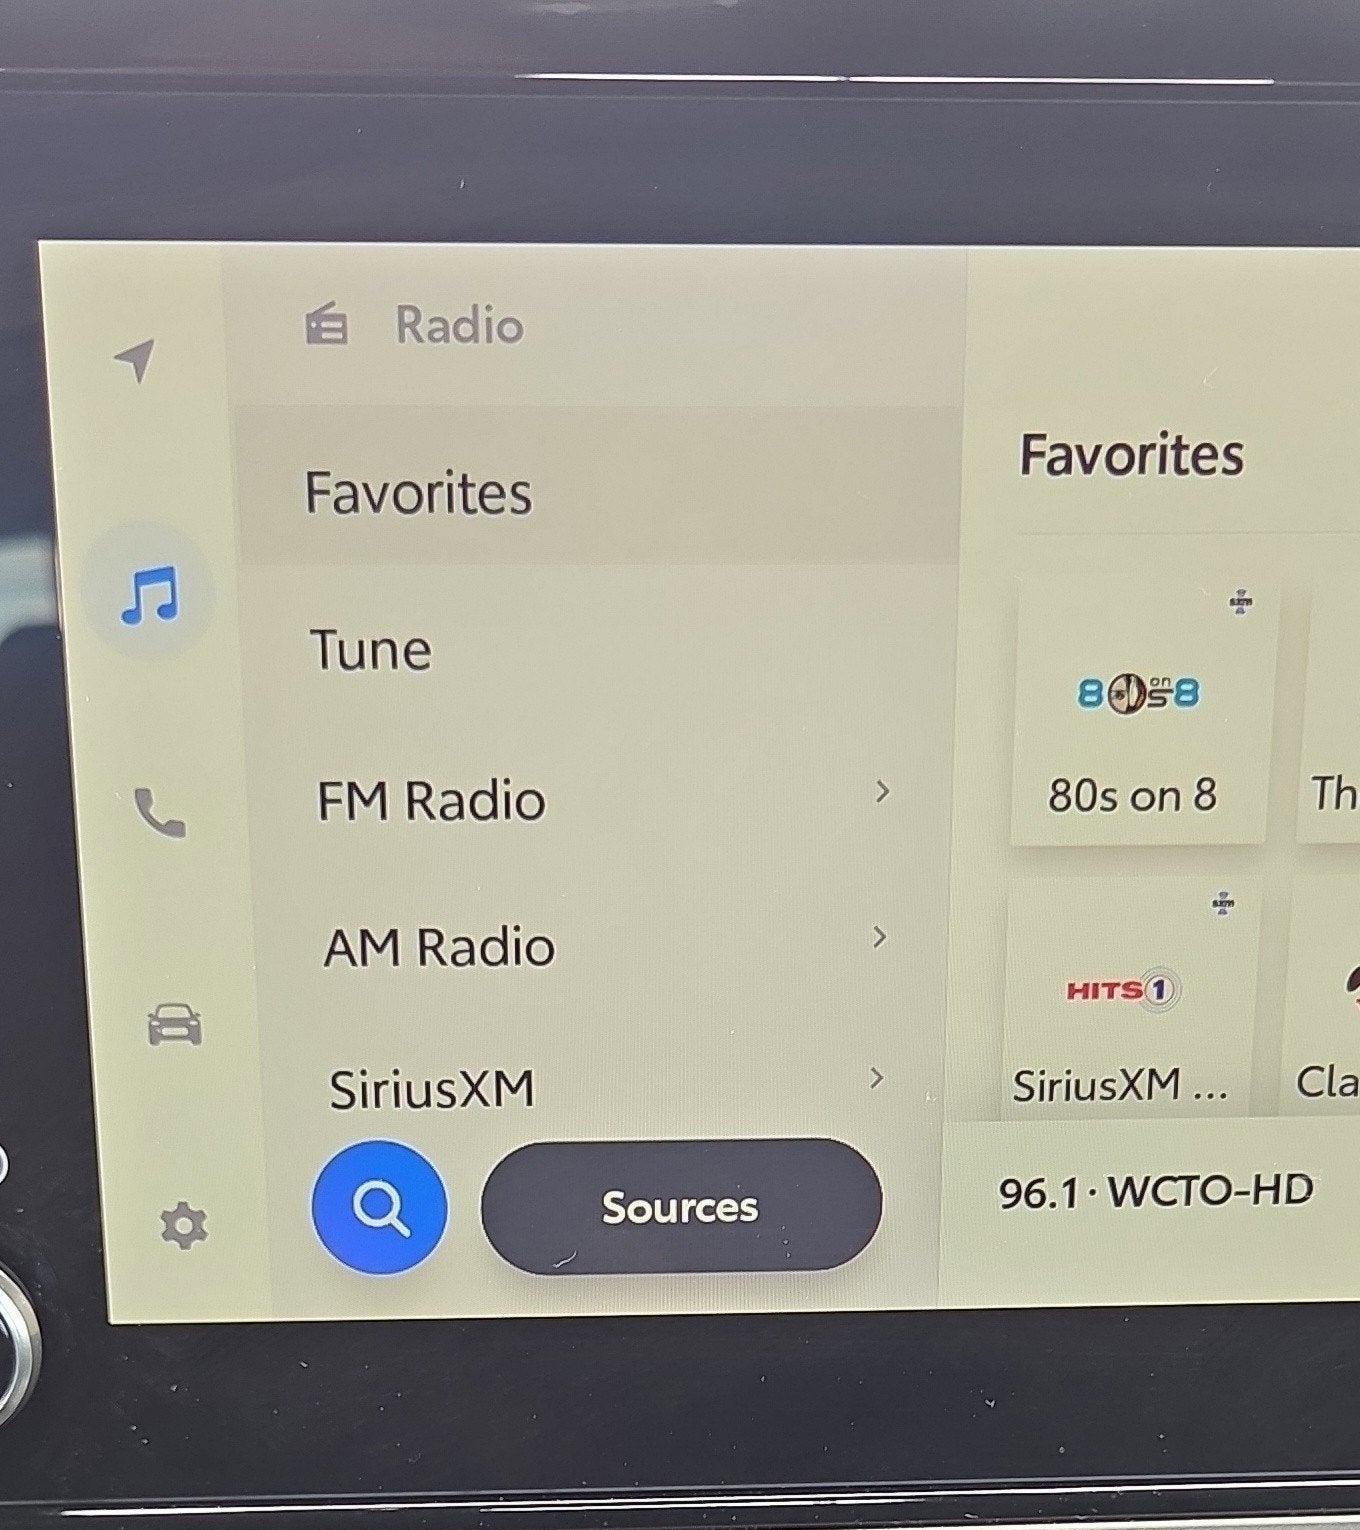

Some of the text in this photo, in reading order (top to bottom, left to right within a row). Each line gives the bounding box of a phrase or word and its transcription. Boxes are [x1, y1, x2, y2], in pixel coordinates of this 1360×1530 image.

[397, 303, 524, 344] Radio
[1021, 429, 1244, 477] Favorites
[306, 468, 532, 515] Favorites
[309, 628, 432, 671] Tune
[319, 777, 546, 822] FM Radio
[1049, 776, 1217, 813] 80s on 8
[323, 924, 555, 967] AM Radio
[1067, 979, 1146, 1000] HITS
[331, 1068, 533, 1110] SiriusXM
[1013, 1067, 1180, 1103] SiriusXM
[603, 1190, 759, 1224] Sources
[1107, 1173, 1314, 1208] WCTO-HD
